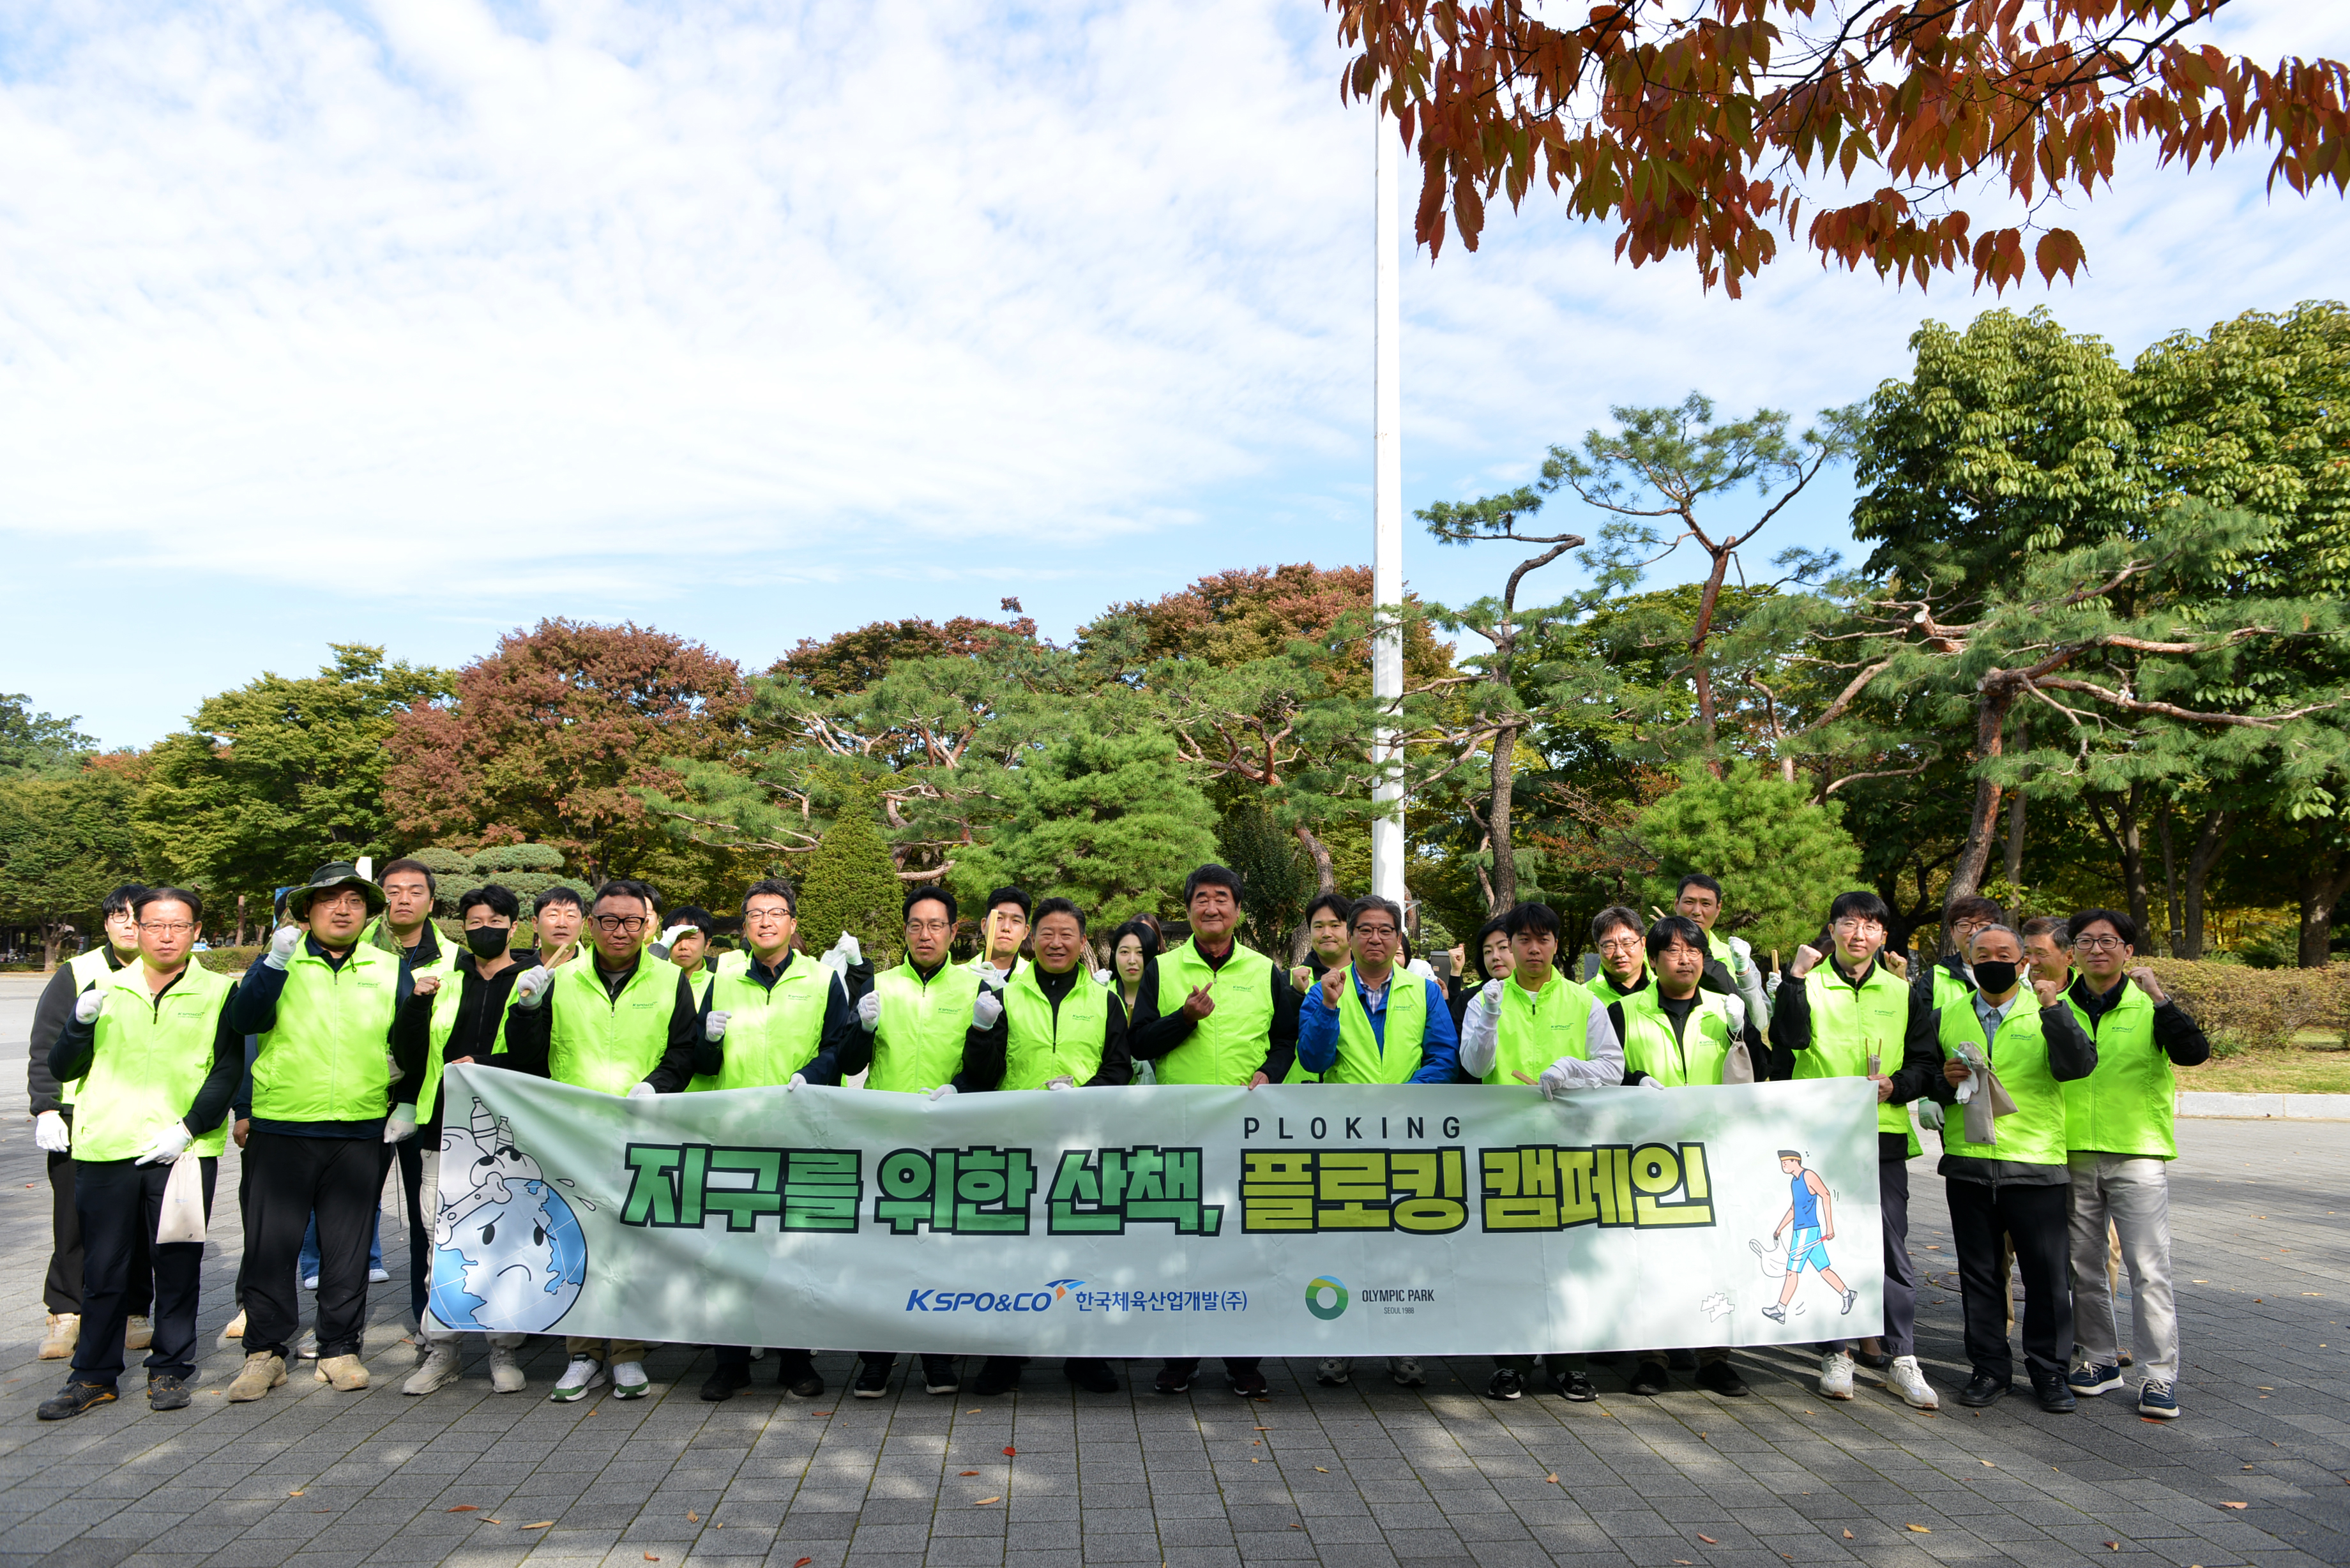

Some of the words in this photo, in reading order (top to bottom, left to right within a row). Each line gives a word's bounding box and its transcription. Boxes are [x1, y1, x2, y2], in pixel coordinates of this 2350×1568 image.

[1244, 1116, 1460, 1140] PLOKING
[619, 1142, 863, 1233] 지구를
[874, 1145, 1037, 1235] 위한
[1045, 1145, 1225, 1236] 산책,
[1239, 1146, 1469, 1235] 플로킹
[1479, 1142, 1716, 1233] 캠페인
[906, 1289, 1052, 1312] KSPO&CO
[1075, 1290, 1248, 1311] 한국체육산업개발(주)
[1361, 1289, 1405, 1302] OLYMPIC
[1407, 1289, 1435, 1302] PARK
